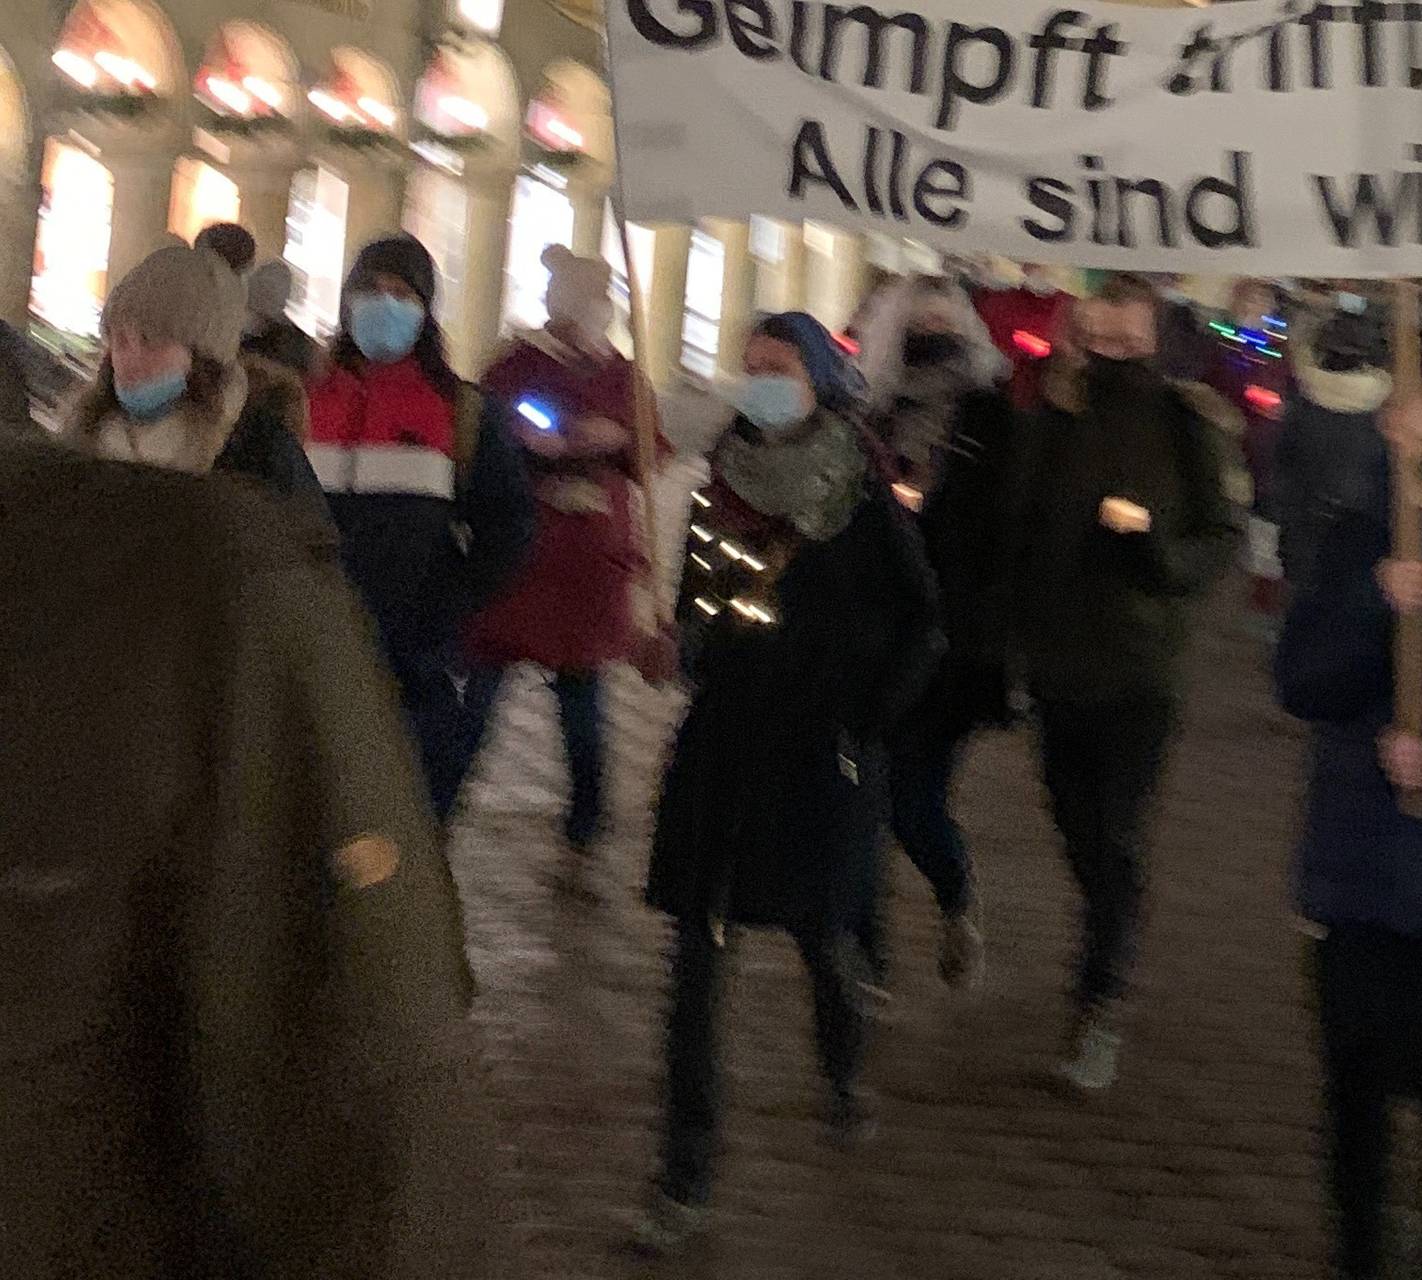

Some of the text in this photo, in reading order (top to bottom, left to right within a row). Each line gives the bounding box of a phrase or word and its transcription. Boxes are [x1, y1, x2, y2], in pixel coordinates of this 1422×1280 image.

[626, 0, 1130, 130] Geimpft
[788, 118, 972, 227] Alle
[1018, 150, 1260, 249] sind
